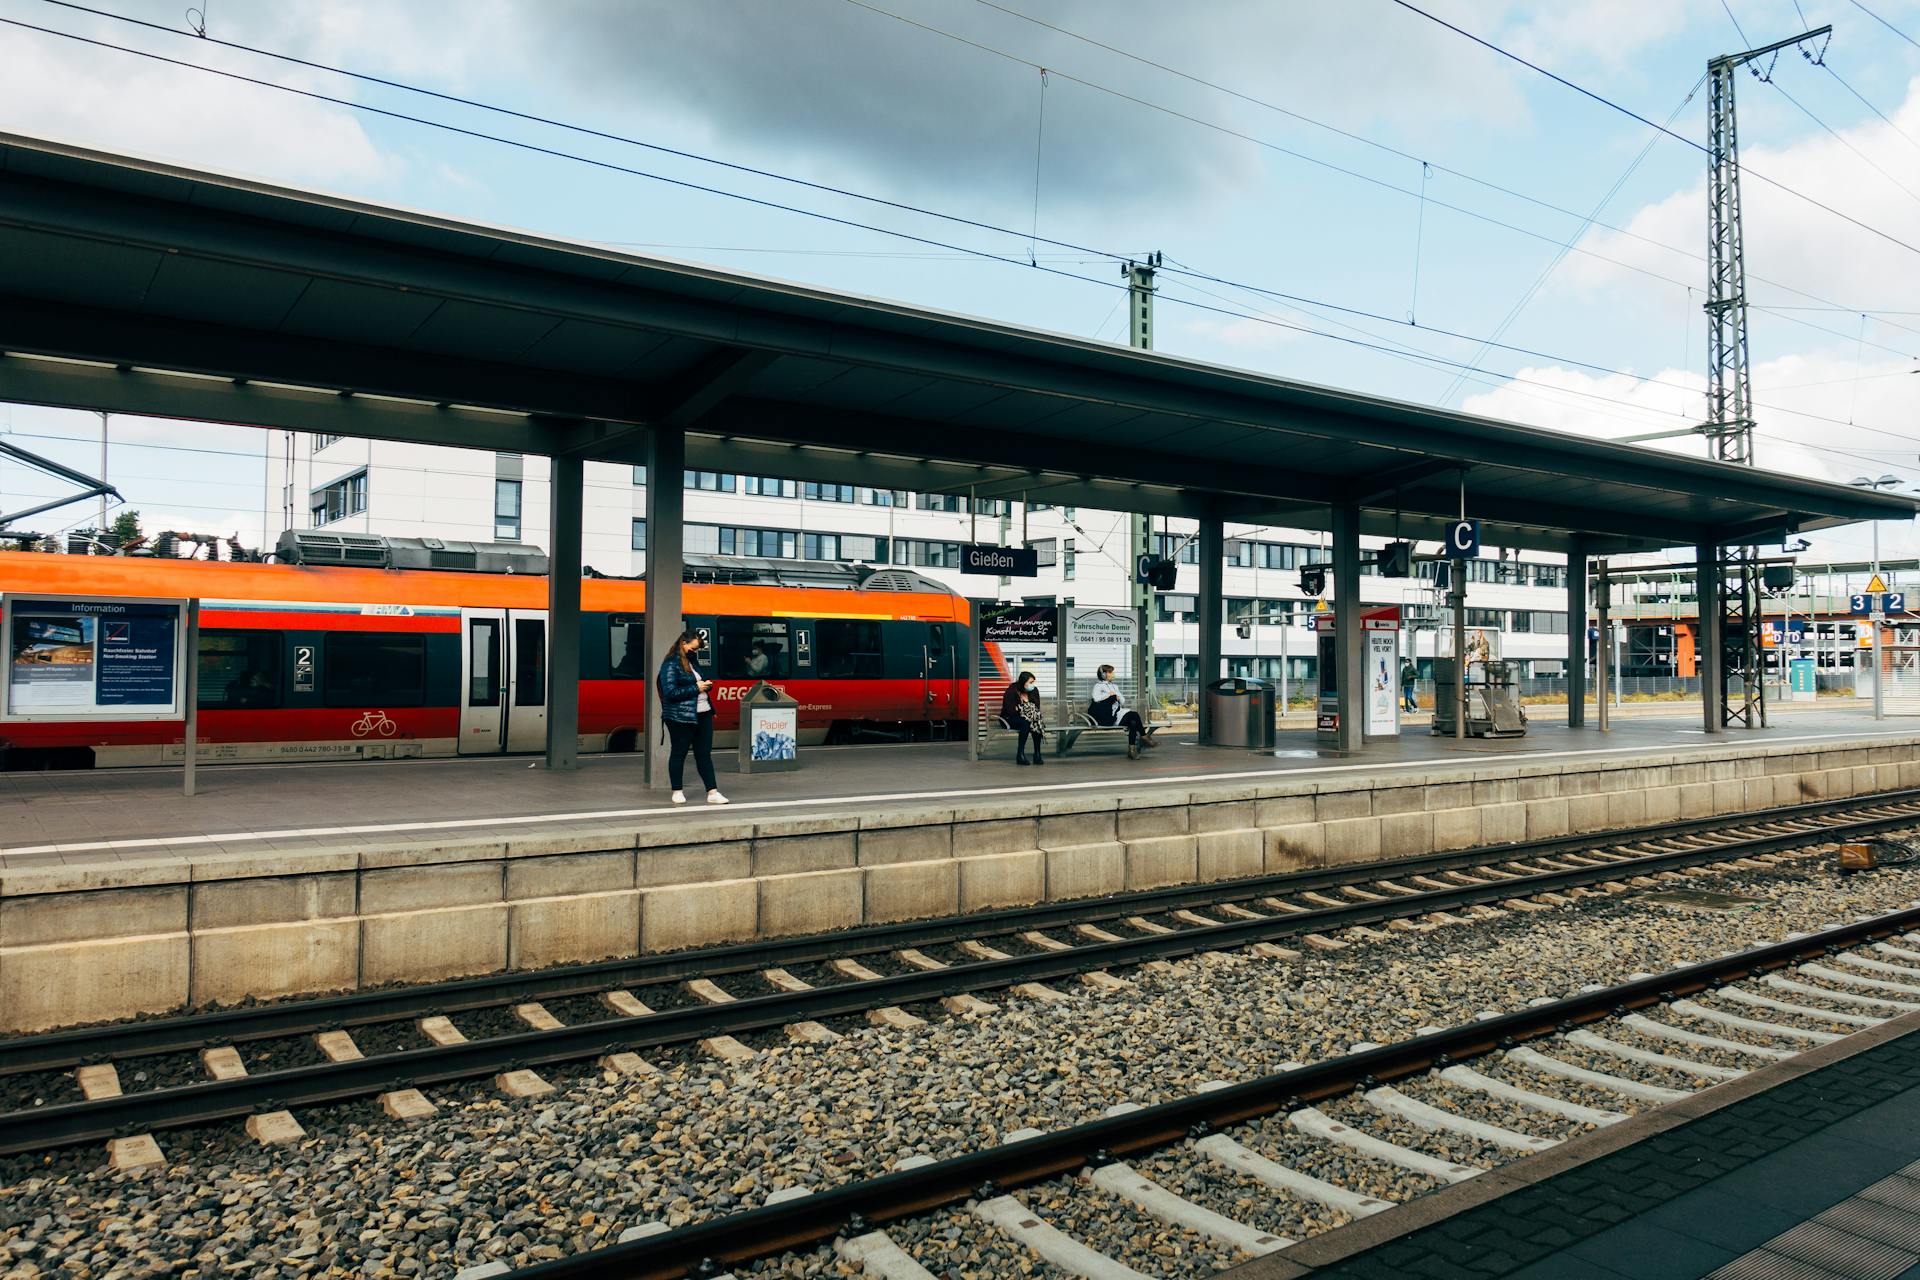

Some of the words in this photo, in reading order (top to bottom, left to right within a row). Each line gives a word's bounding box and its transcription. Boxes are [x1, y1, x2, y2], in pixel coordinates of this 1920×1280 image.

[1454, 522, 1473, 550] C
[970, 551, 1014, 568] Gießen
[1139, 555, 1151, 578] C
[71, 603, 126, 613] Information
[1853, 595, 1864, 610] 3
[1890, 593, 1902, 609] 2
[996, 616, 1052, 635] Einrahmungen
[1073, 623, 1110, 631] Fahrschule
[1111, 623, 1131, 631] Demir
[1308, 616, 1316, 628] 5
[798, 631, 806, 645] 1
[985, 626, 1049, 636] Künstlerbedarf
[1774, 632, 1781, 643] D
[1792, 632, 1800, 643] D
[298, 648, 310, 665] 2
[717, 686, 750, 701] REG
[760, 719, 788, 731] Papier
